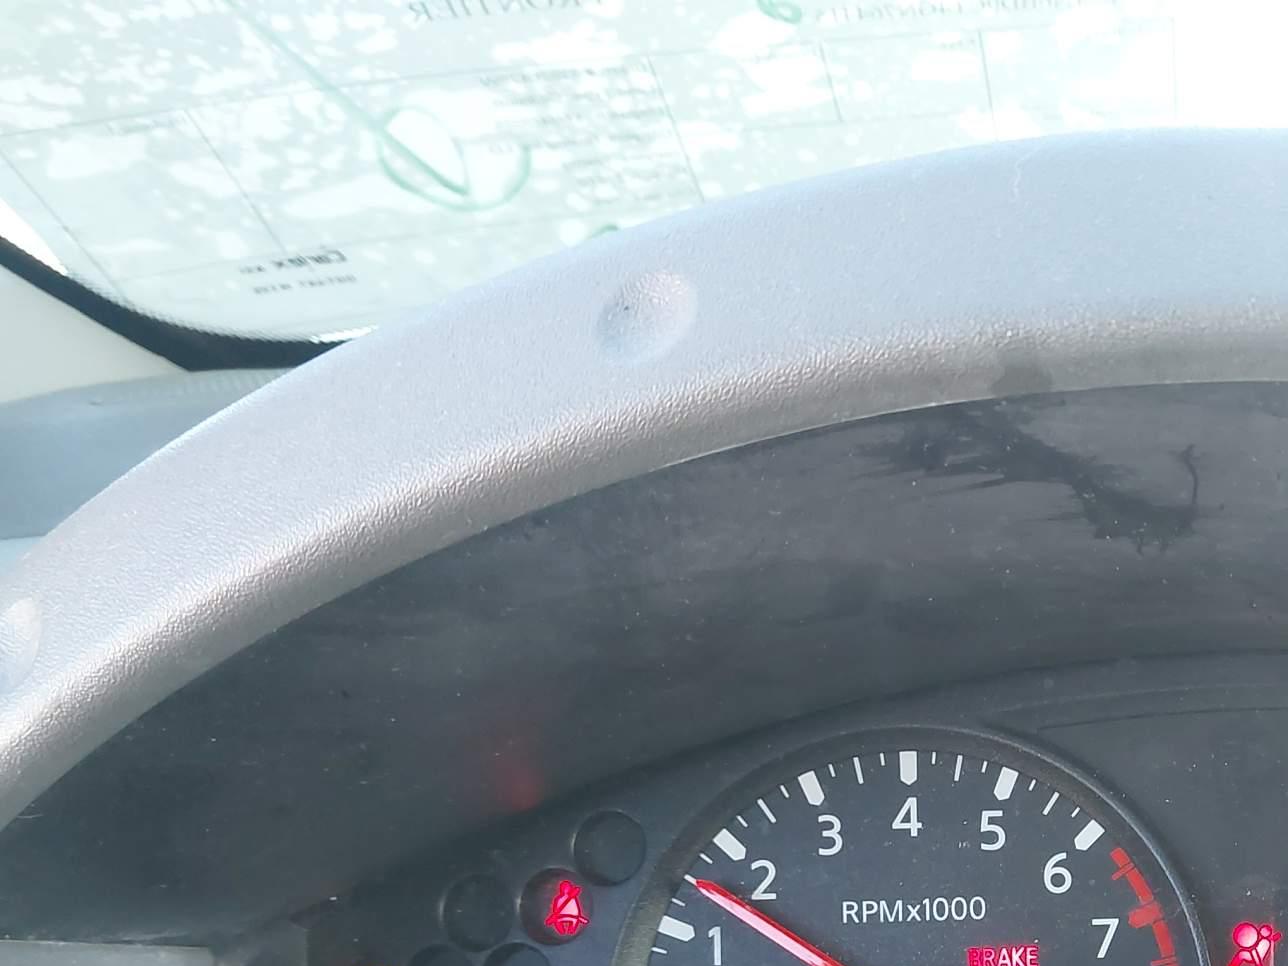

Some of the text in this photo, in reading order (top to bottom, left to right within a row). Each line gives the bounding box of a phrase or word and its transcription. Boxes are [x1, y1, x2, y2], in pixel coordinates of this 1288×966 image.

[817, 814, 843, 856] 3
[891, 796, 923, 837] 4
[980, 810, 1006, 851] 5
[750, 859, 777, 900] 2
[1043, 852, 1072, 894] 6
[842, 896, 986, 924] RPMx1000
[708, 926, 722, 966] 1
[1091, 918, 1120, 959] 7
